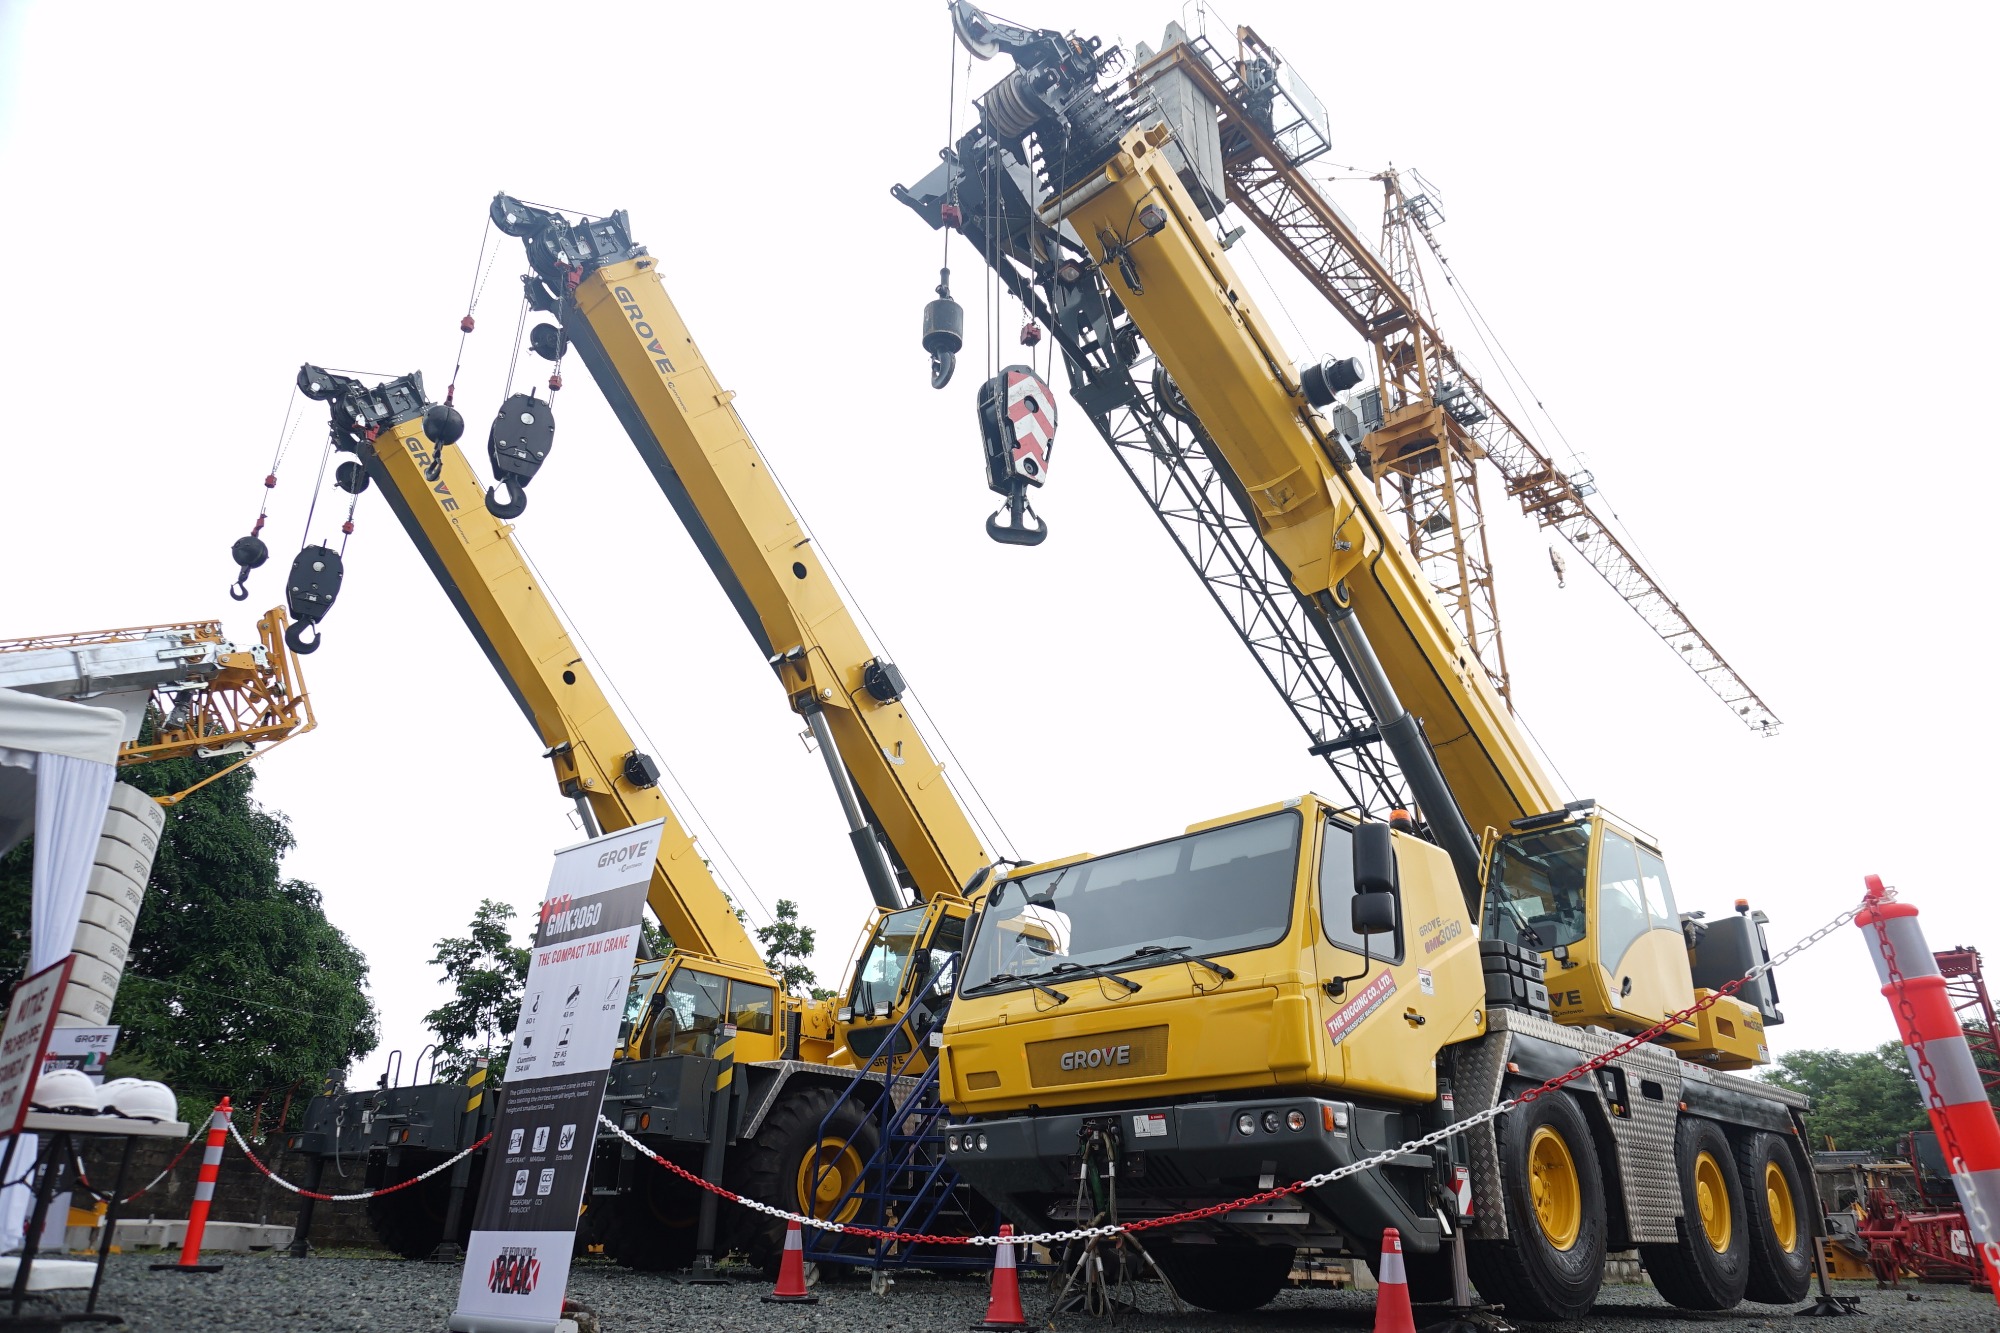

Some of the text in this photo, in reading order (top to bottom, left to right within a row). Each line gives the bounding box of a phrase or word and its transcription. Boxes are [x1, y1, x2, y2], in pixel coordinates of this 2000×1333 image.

[614, 286, 676, 374] GROVE
[597, 840, 650, 868] GROVE
[546, 902, 602, 937] GMK3060
[1419, 916, 1442, 937] GROVE
[538, 934, 630, 967] THE COMPACT TAXI CRANE
[1328, 1014, 1345, 1034] THE
[1342, 993, 1369, 1022] RIGGING
[1377, 974, 1392, 991] LTD.
[1334, 986, 1396, 1044] MEGA TRANSPORT MACHINERY MOVERS
[74, 1034, 109, 1043] GROVE
[517, 1055, 536, 1064] Cummins
[554, 1051, 560, 1059] ZF
[1060, 1045, 1130, 1071] GROVE
